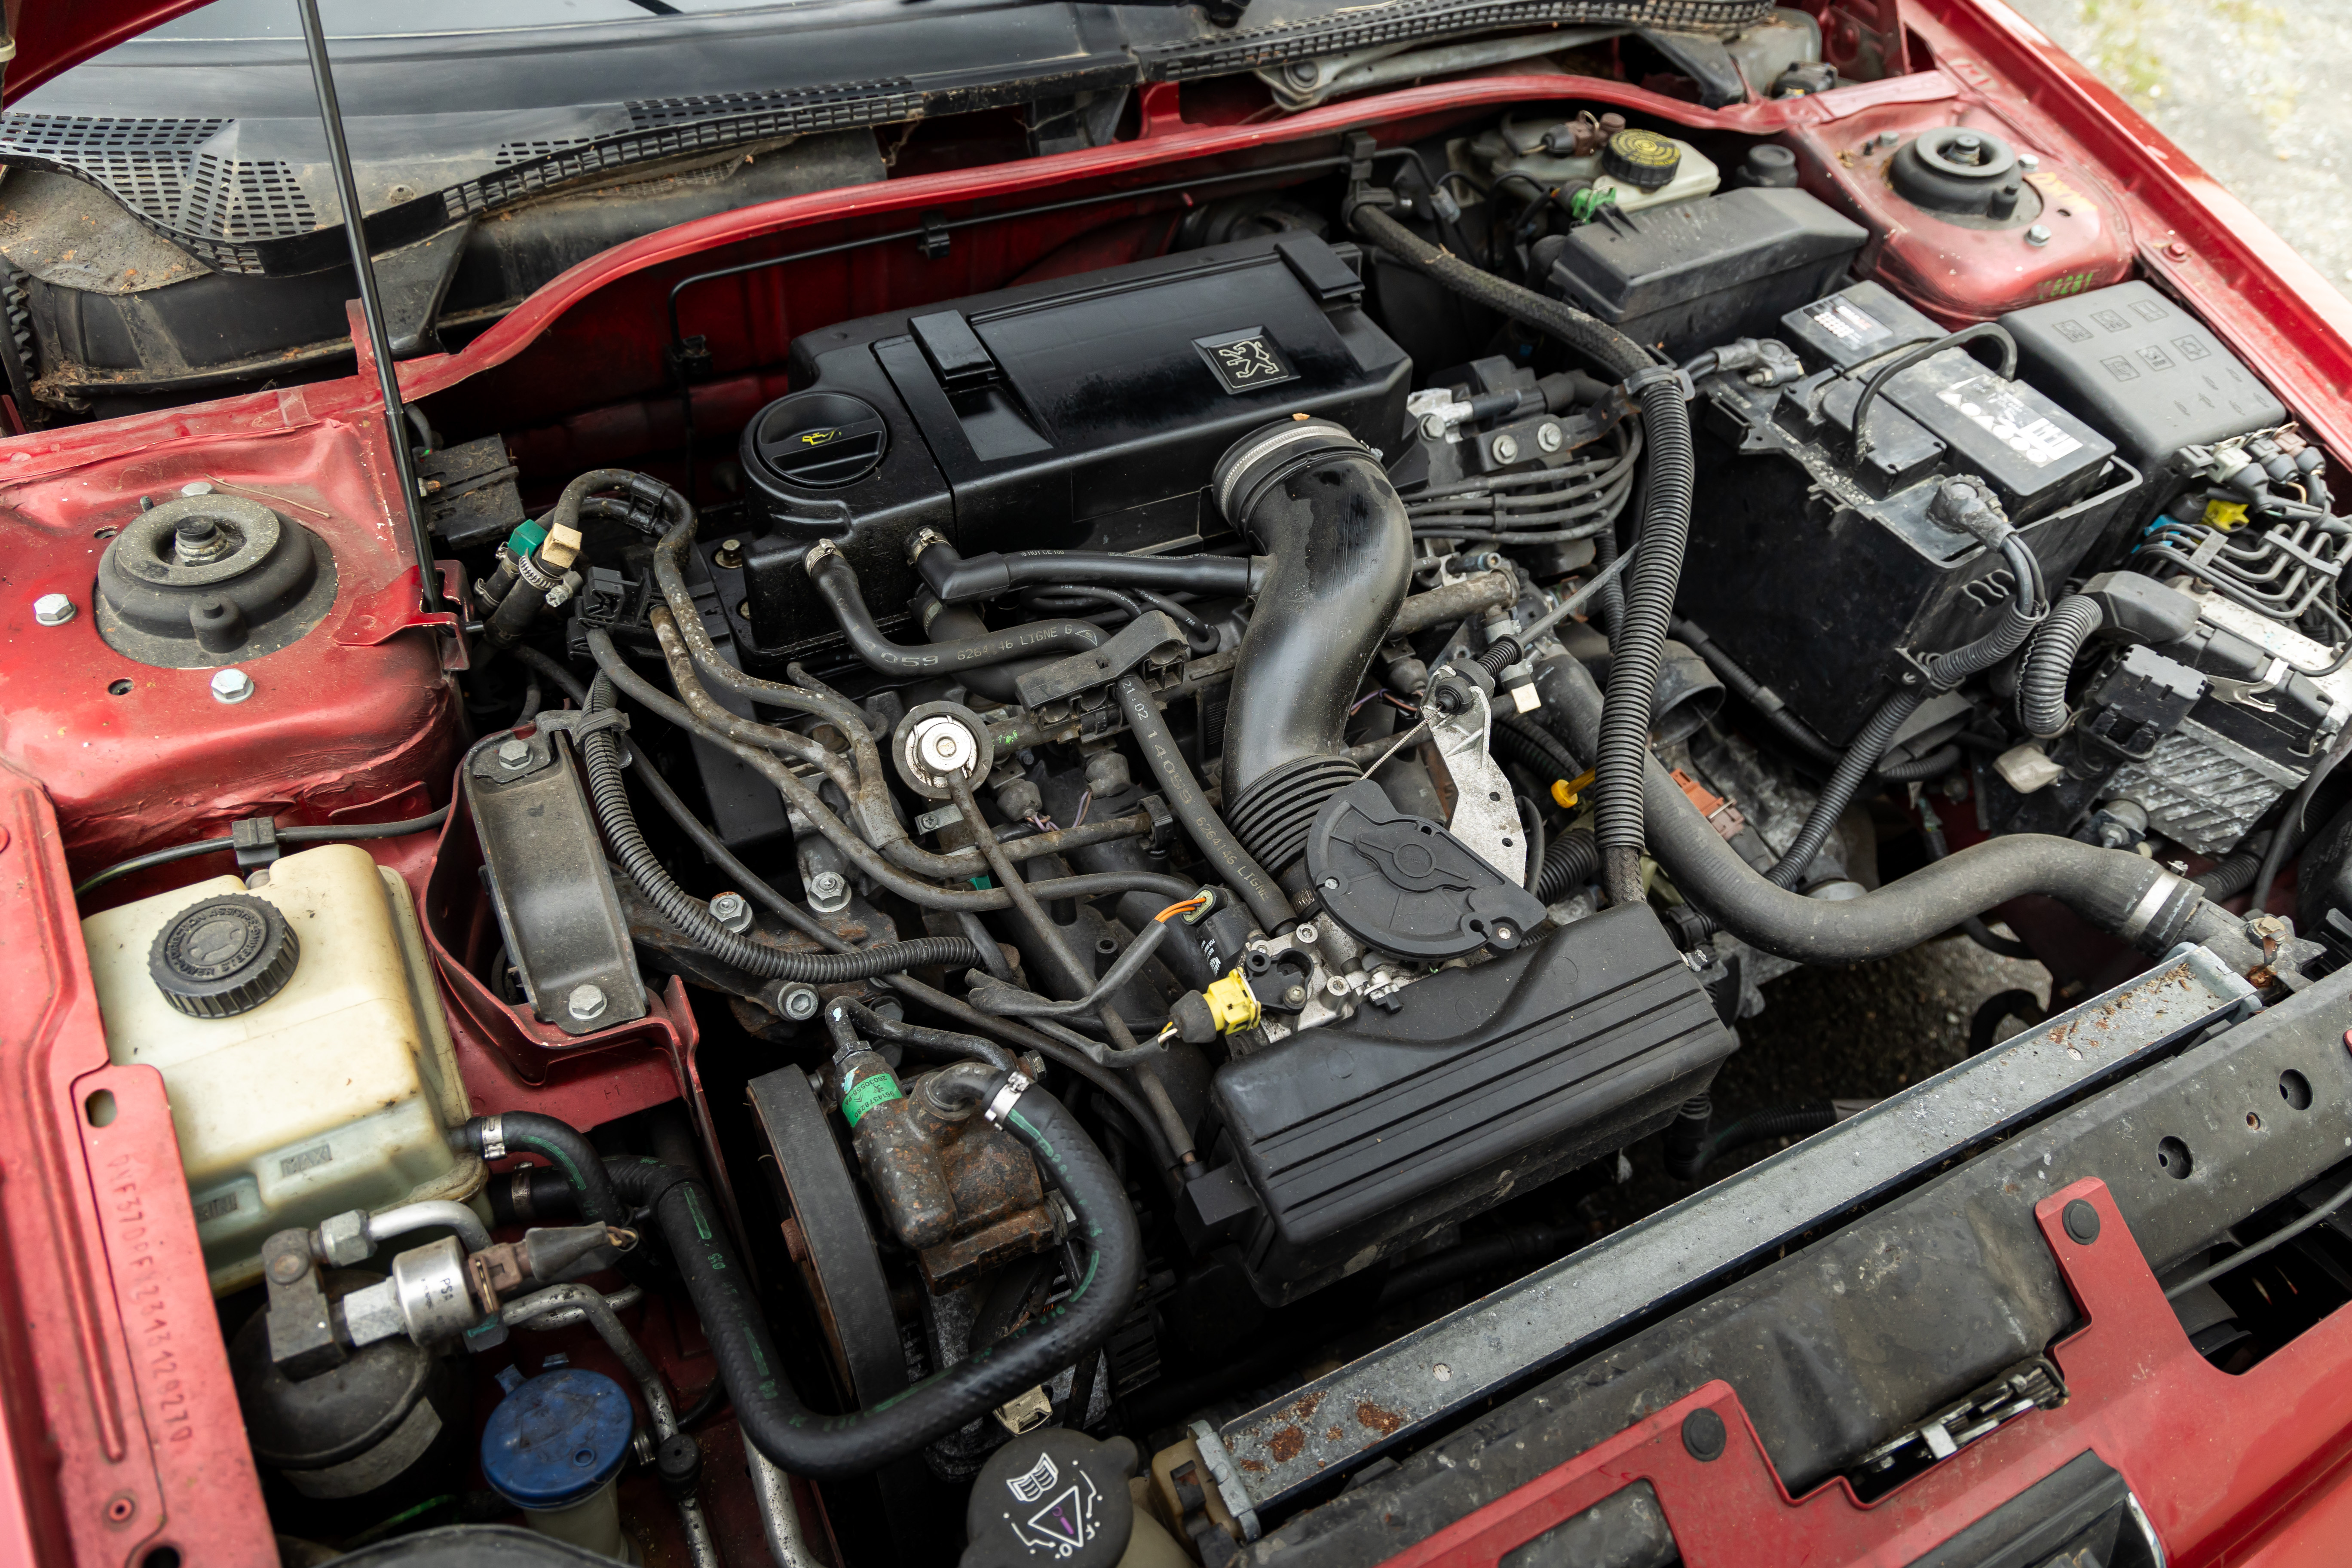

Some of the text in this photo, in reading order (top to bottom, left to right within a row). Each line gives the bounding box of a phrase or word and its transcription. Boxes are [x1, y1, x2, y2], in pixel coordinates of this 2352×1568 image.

[1020, 627, 1058, 646] LIGNE
[1065, 624, 1072, 635] G
[1123, 681, 1149, 721] 21:02
[845, 1075, 888, 1106] 26030558-PA
[854, 1090, 895, 1118] 9614378280
[440, 1277, 453, 1302] PSA
